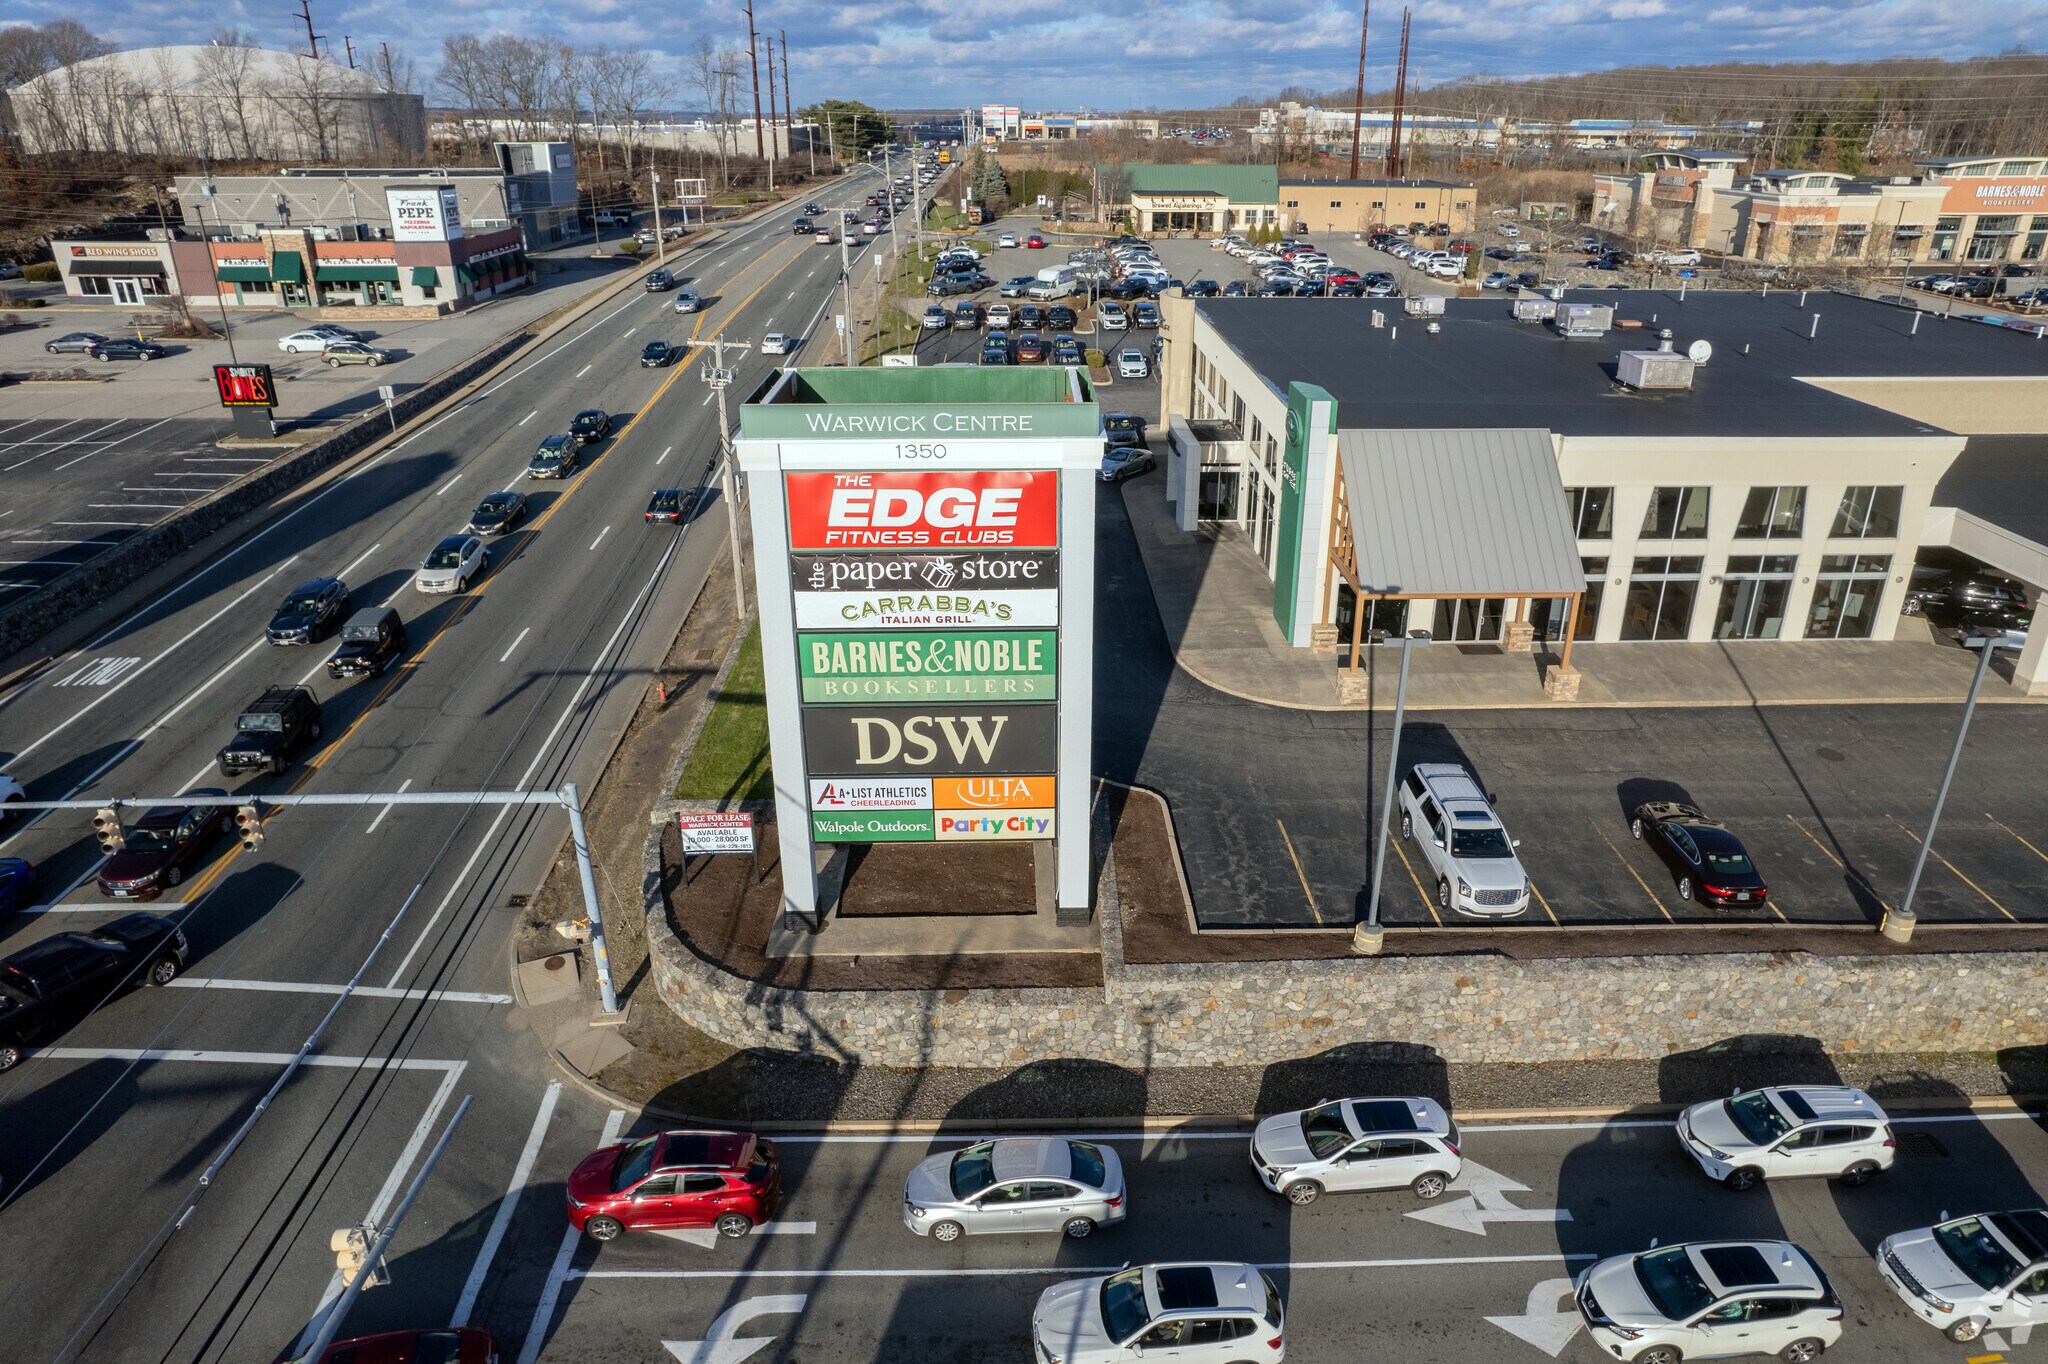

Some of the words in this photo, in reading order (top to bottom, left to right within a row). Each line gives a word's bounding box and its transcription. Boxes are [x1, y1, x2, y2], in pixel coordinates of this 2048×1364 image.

[1976, 185, 2046, 198] BARNES&NOBLE
[397, 207, 434, 218] PEPE
[86, 248, 102, 256] RED
[104, 248, 128, 256] WING
[130, 248, 156, 256] SHOES
[229, 367, 255, 377] SMOKEY
[217, 367, 267, 401] BONES
[805, 413, 926, 432] WARWICK
[933, 412, 1033, 432] CENTRE
[895, 444, 947, 459] 1350
[834, 475, 872, 487] THE
[827, 487, 1023, 528] EDGE
[825, 531, 930, 545] FITNESS
[940, 530, 1014, 544] CLUBS
[808, 562, 825, 589] the
[830, 560, 917, 589] paper
[962, 556, 1039, 580] store
[841, 594, 1013, 621] CARRABBA'S
[881, 616, 931, 624] ITALIAN
[936, 616, 972, 624] GRILL
[812, 639, 1043, 674] BARNES&NOBLE
[52, 657, 141, 687] ONLY
[825, 678, 1035, 695] BOOKSELLERS
[851, 715, 1009, 766] DSW
[875, 787, 927, 798] ATHLETICS
[967, 778, 1031, 797] ULTA
[681, 815, 705, 823] SPACE
[941, 817, 1004, 834] Party
[1007, 816, 1049, 833] City
[815, 821, 864, 835] Walpole
[867, 820, 927, 832] Outdoors
